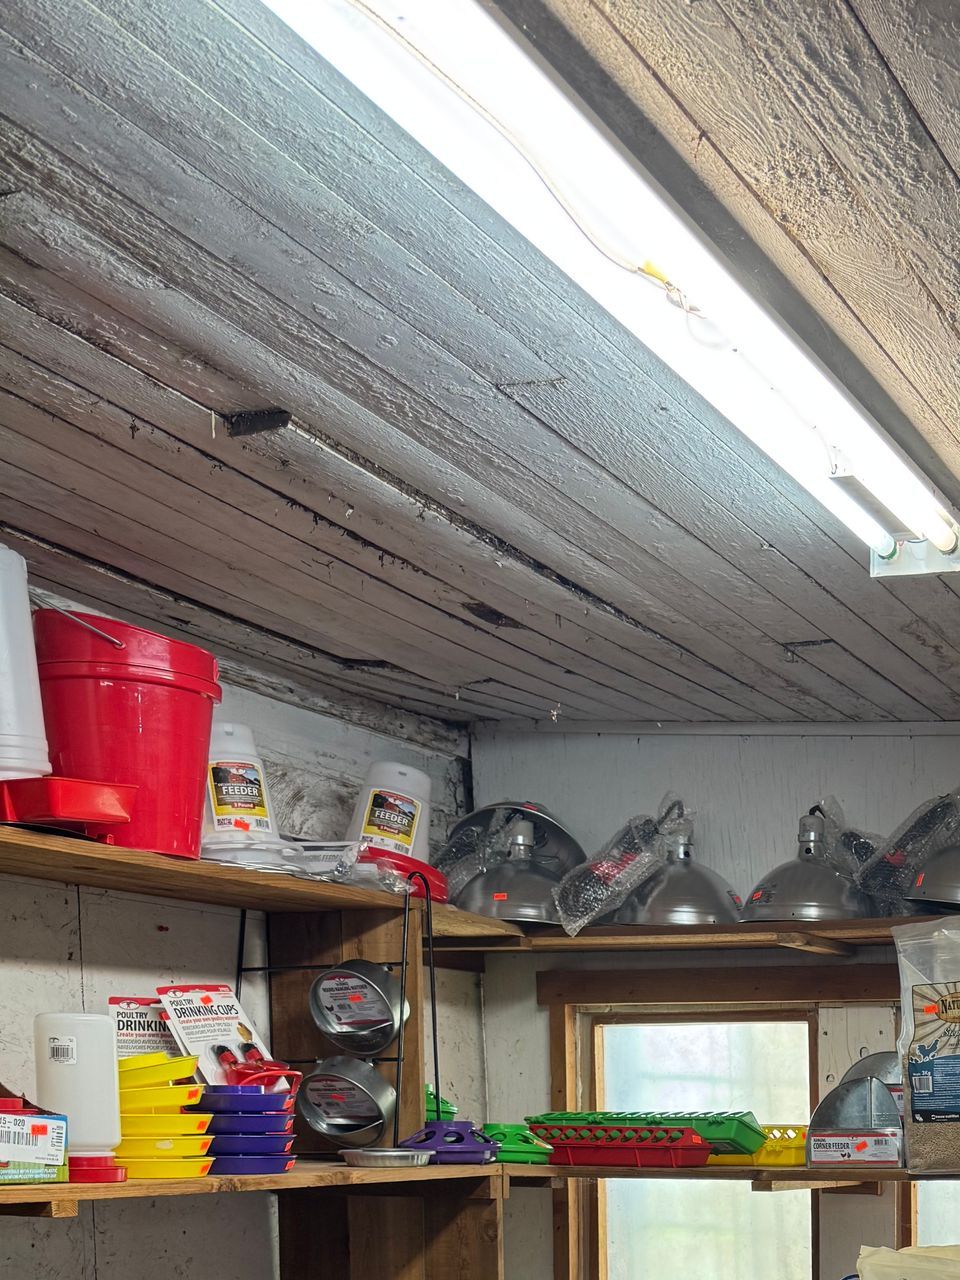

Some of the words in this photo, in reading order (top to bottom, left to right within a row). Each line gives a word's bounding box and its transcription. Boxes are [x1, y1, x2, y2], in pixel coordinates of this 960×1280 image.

[222, 786, 259, 797] FEEDER
[375, 810, 409, 826] FEEDER
[169, 998, 194, 1007] POULTRY
[174, 1006, 219, 1019] DRINKING
[218, 1004, 239, 1016] CUPS
[944, 1027, 960, 1038] Step
[813, 1142, 833, 1150] CORNER
[832, 1142, 850, 1150] FEEDER
